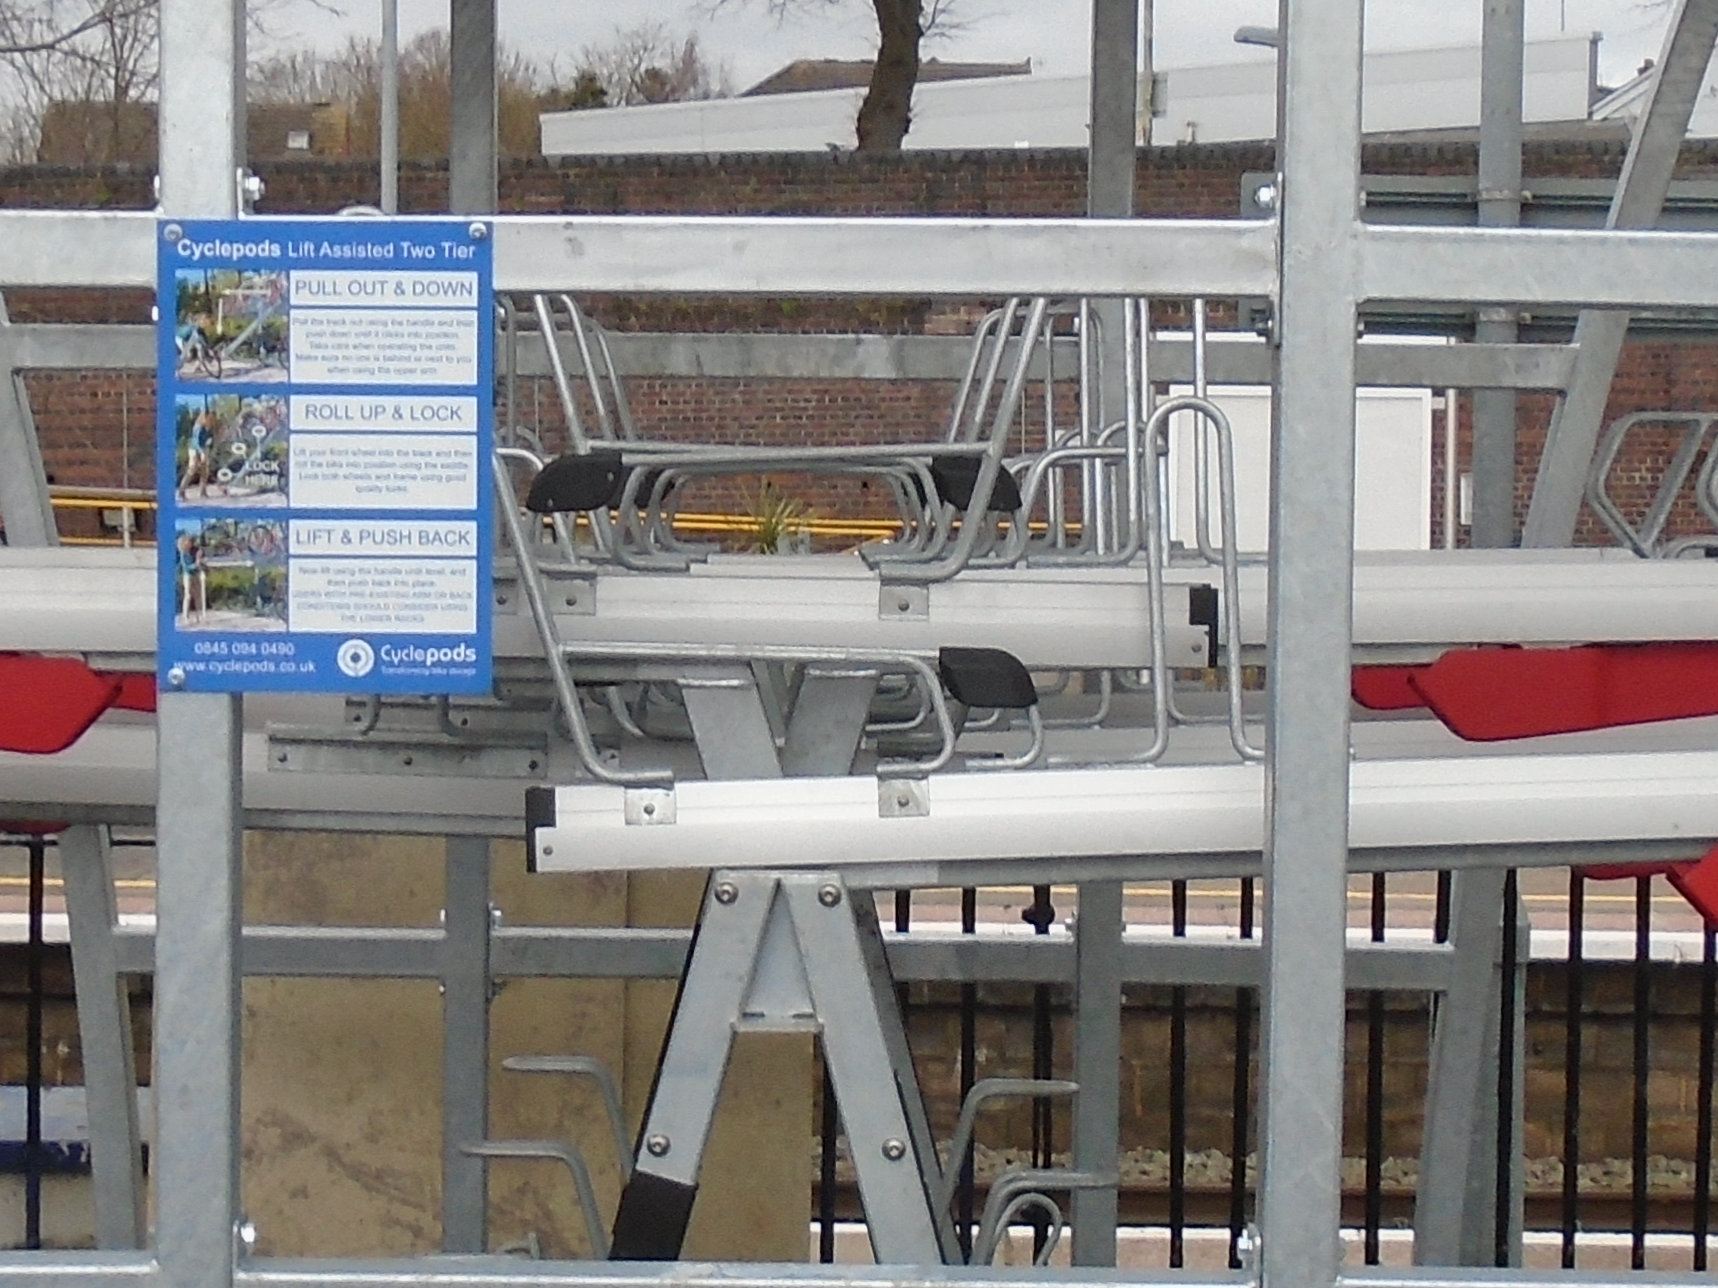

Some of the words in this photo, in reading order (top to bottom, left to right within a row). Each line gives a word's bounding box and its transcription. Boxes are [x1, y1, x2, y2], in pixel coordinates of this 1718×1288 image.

[177, 239, 282, 262] Cyclepods
[288, 241, 314, 258] Lift
[319, 241, 393, 258] Assisted
[401, 242, 435, 258] Two
[442, 241, 477, 259] Tier
[296, 280, 342, 296] PULL
[348, 280, 388, 296] OUT
[394, 281, 405, 296] &
[413, 280, 472, 297] DOWN
[305, 404, 354, 420] ROLL
[361, 405, 386, 420] UP
[392, 405, 403, 420] &
[410, 405, 462, 421] LOCK
[296, 529, 334, 545] LIFT
[341, 529, 352, 545] &
[359, 529, 411, 545] PUSH
[419, 530, 470, 546] BACK
[381, 642, 477, 666] Cyclepods
[173, 660, 316, 675] www.cyclepods.co.uk
